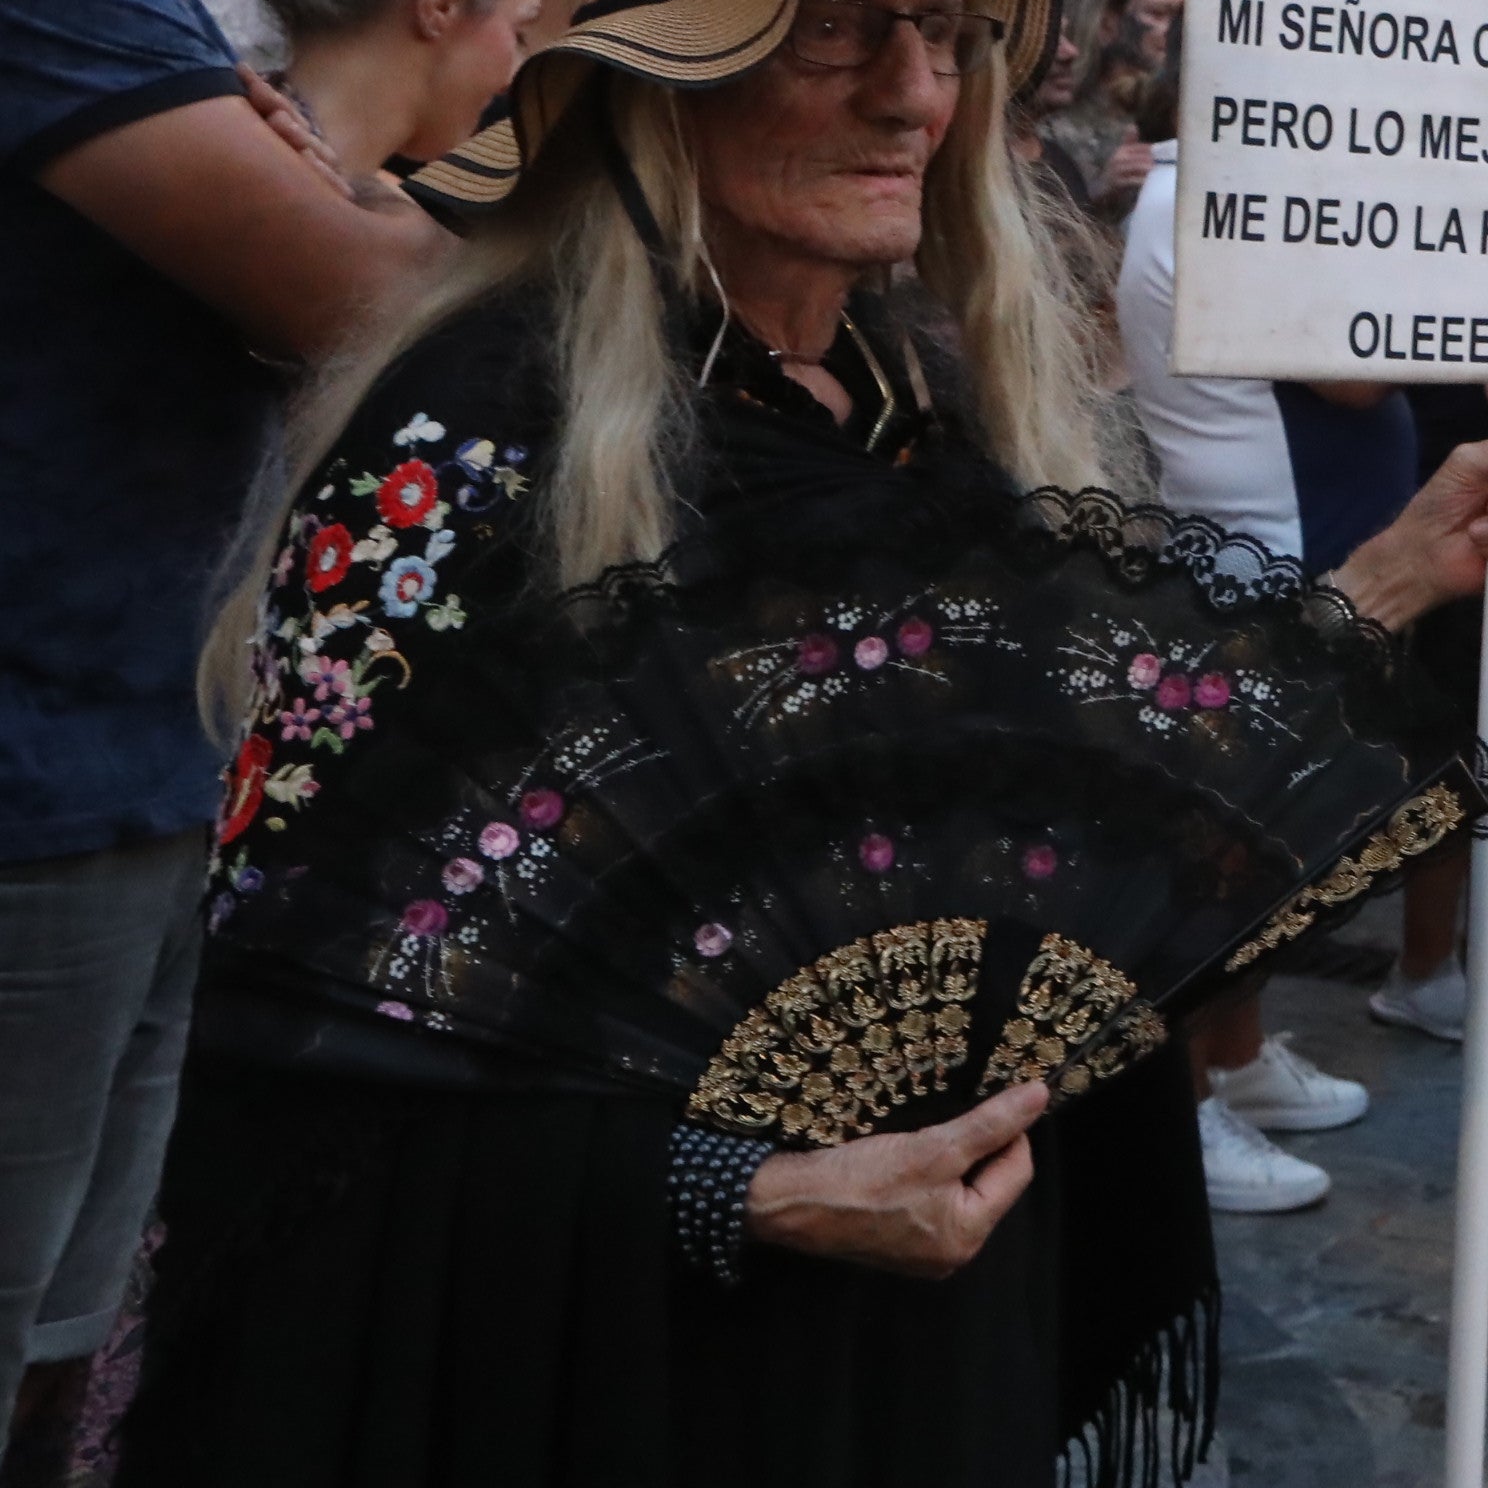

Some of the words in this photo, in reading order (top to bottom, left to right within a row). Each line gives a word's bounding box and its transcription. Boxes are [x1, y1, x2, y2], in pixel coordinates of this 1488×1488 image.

[1211, 95, 1333, 152] PERO
[1348, 107, 1405, 157] LO
[1202, 190, 1268, 242] ME
[1283, 195, 1399, 249] DEJO
[1414, 206, 1467, 254] LA
